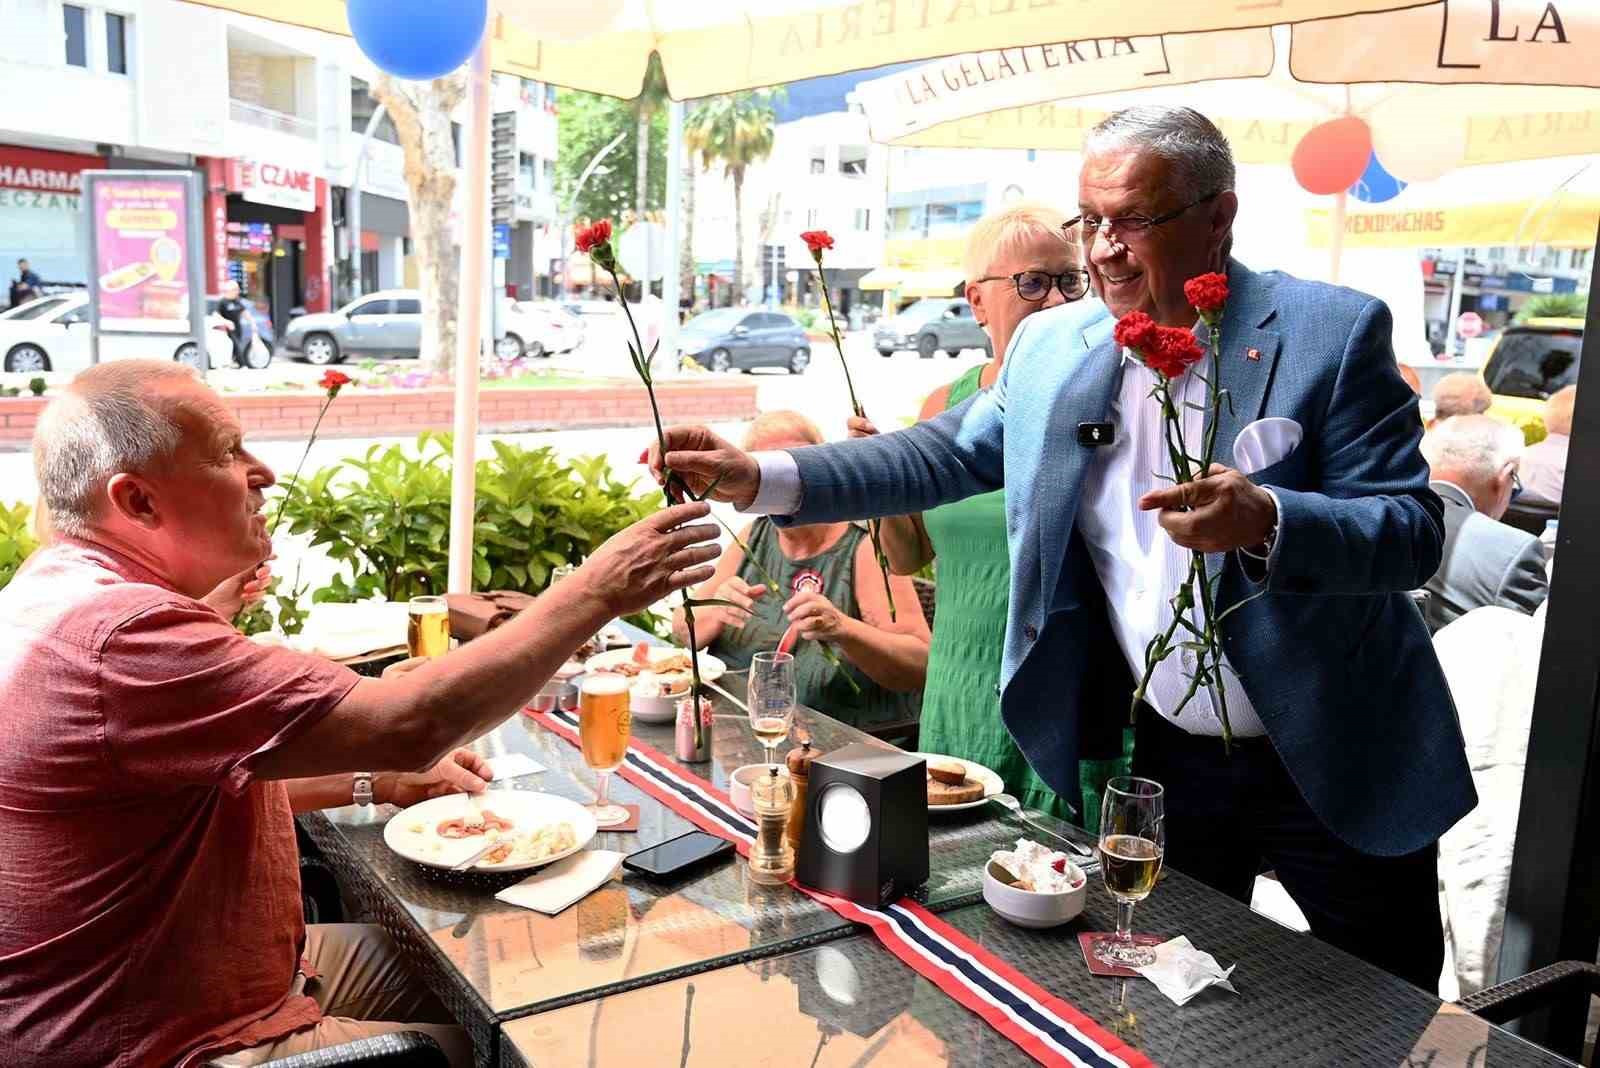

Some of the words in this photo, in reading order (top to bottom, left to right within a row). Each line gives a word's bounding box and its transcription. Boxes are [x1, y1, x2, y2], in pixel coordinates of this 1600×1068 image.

[1482, 0, 1571, 43] LA
[905, 78, 938, 105] LA
[942, 36, 1140, 93] GELATERIA
